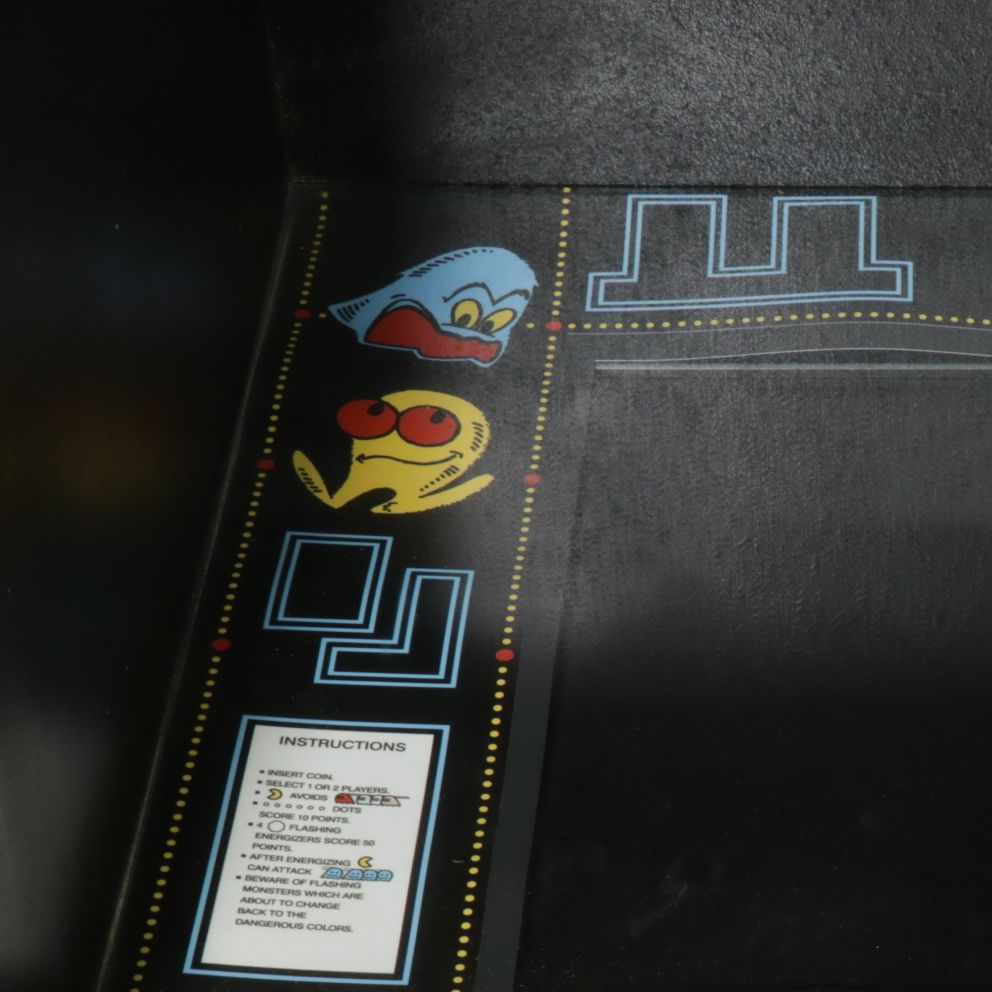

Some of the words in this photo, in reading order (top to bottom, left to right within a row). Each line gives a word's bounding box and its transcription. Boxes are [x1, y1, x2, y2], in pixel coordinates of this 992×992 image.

[279, 736, 407, 752] INSTRUCTIONS
[267, 769, 304, 779] INSERT
[306, 771, 335, 781] COIN.
[266, 779, 305, 789] SELECT
[315, 782, 330, 791] OR
[333, 783, 339, 791] 2
[341, 785, 390, 794] PLAYERS.
[289, 792, 328, 801] AVOIDS
[332, 805, 362, 814] DOTS
[259, 811, 295, 820] SCORE
[298, 813, 309, 821] 10
[311, 814, 351, 824] POINTS.
[289, 824, 342, 834] FLASHING
[255, 832, 321, 844] ENERGIZERS
[324, 837, 360, 846] SCORE
[363, 839, 375, 847] 50
[252, 843, 293, 853] POINTS.
[249, 853, 284, 863] AFTER
[286, 855, 350, 867] ENERGIZING
[248, 864, 269, 873] CAN
[272, 865, 312, 875] ATTACK
[245, 875, 289, 885] BEWARE
[292, 877, 308, 886] OF
[309, 879, 362, 889] FLASHING
[242, 885, 302, 896] MONSTERS
[304, 890, 340, 899] WHICH
[342, 891, 364, 900] ARE
[240, 896, 276, 906] ABOUT
[279, 898, 293, 907] TO
[296, 899, 341, 910] CHANGE
[237, 907, 267, 916] BACK
[270, 909, 284, 917] TO
[286, 910, 307, 919] THE
[235, 918, 304, 930] DANGEROUS
[306, 923, 354, 933] COLORS.
